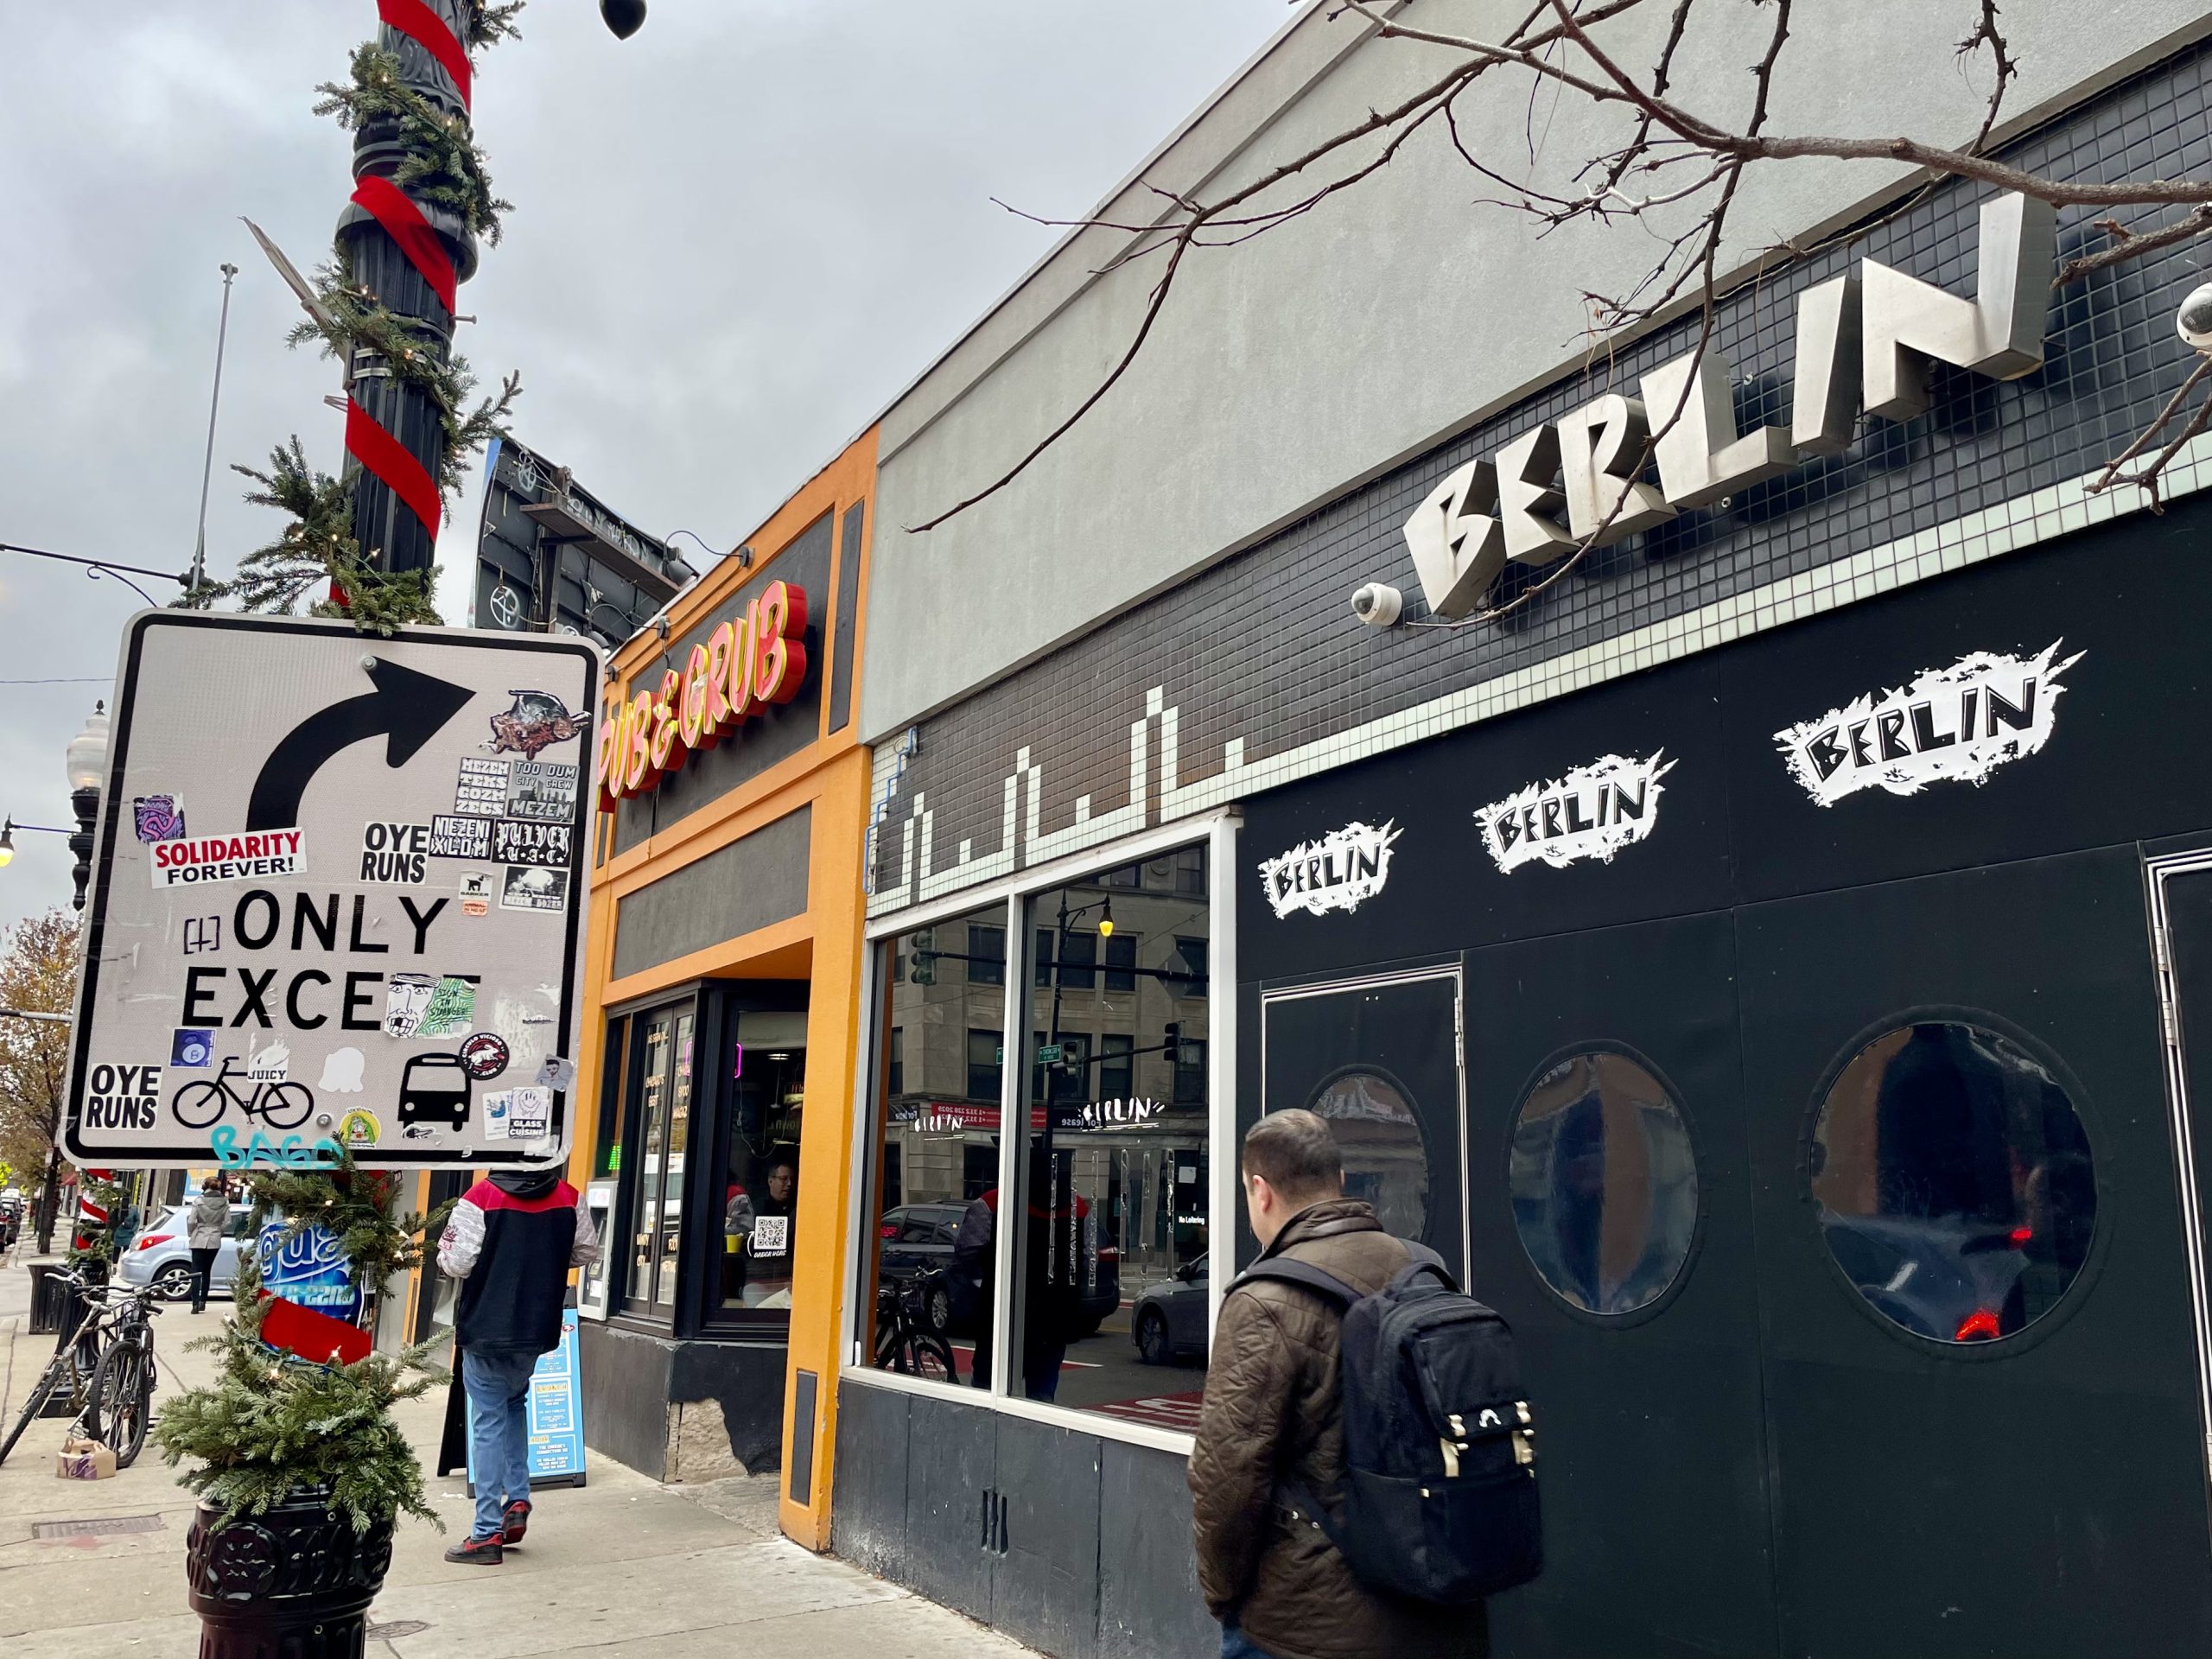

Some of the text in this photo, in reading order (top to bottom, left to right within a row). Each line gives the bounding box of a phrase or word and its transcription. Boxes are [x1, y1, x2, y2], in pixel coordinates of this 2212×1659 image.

[1403, 191, 2057, 618] BERLIN
[679, 580, 808, 748] GRUB
[1806, 674, 2037, 783] BERLIN
[461, 759, 510, 775] MEZEM
[515, 761, 576, 779] TOO DUM
[516, 777, 574, 790] CITY CREW
[510, 799, 570, 818] MEZEM
[1495, 776, 1647, 854] BERLIN
[156, 831, 302, 868] SOLIDARITY
[365, 823, 429, 853] OYE
[168, 857, 294, 884] FOREVER!
[360, 852, 426, 883] RUNS
[1273, 842, 1381, 901] BERLIN
[233, 890, 450, 955] ONLY
[181, 966, 480, 1031] EXCE
[92, 1065, 162, 1096] OYE
[248, 1070, 287, 1080] JUICY
[86, 1096, 156, 1129] RUNS
